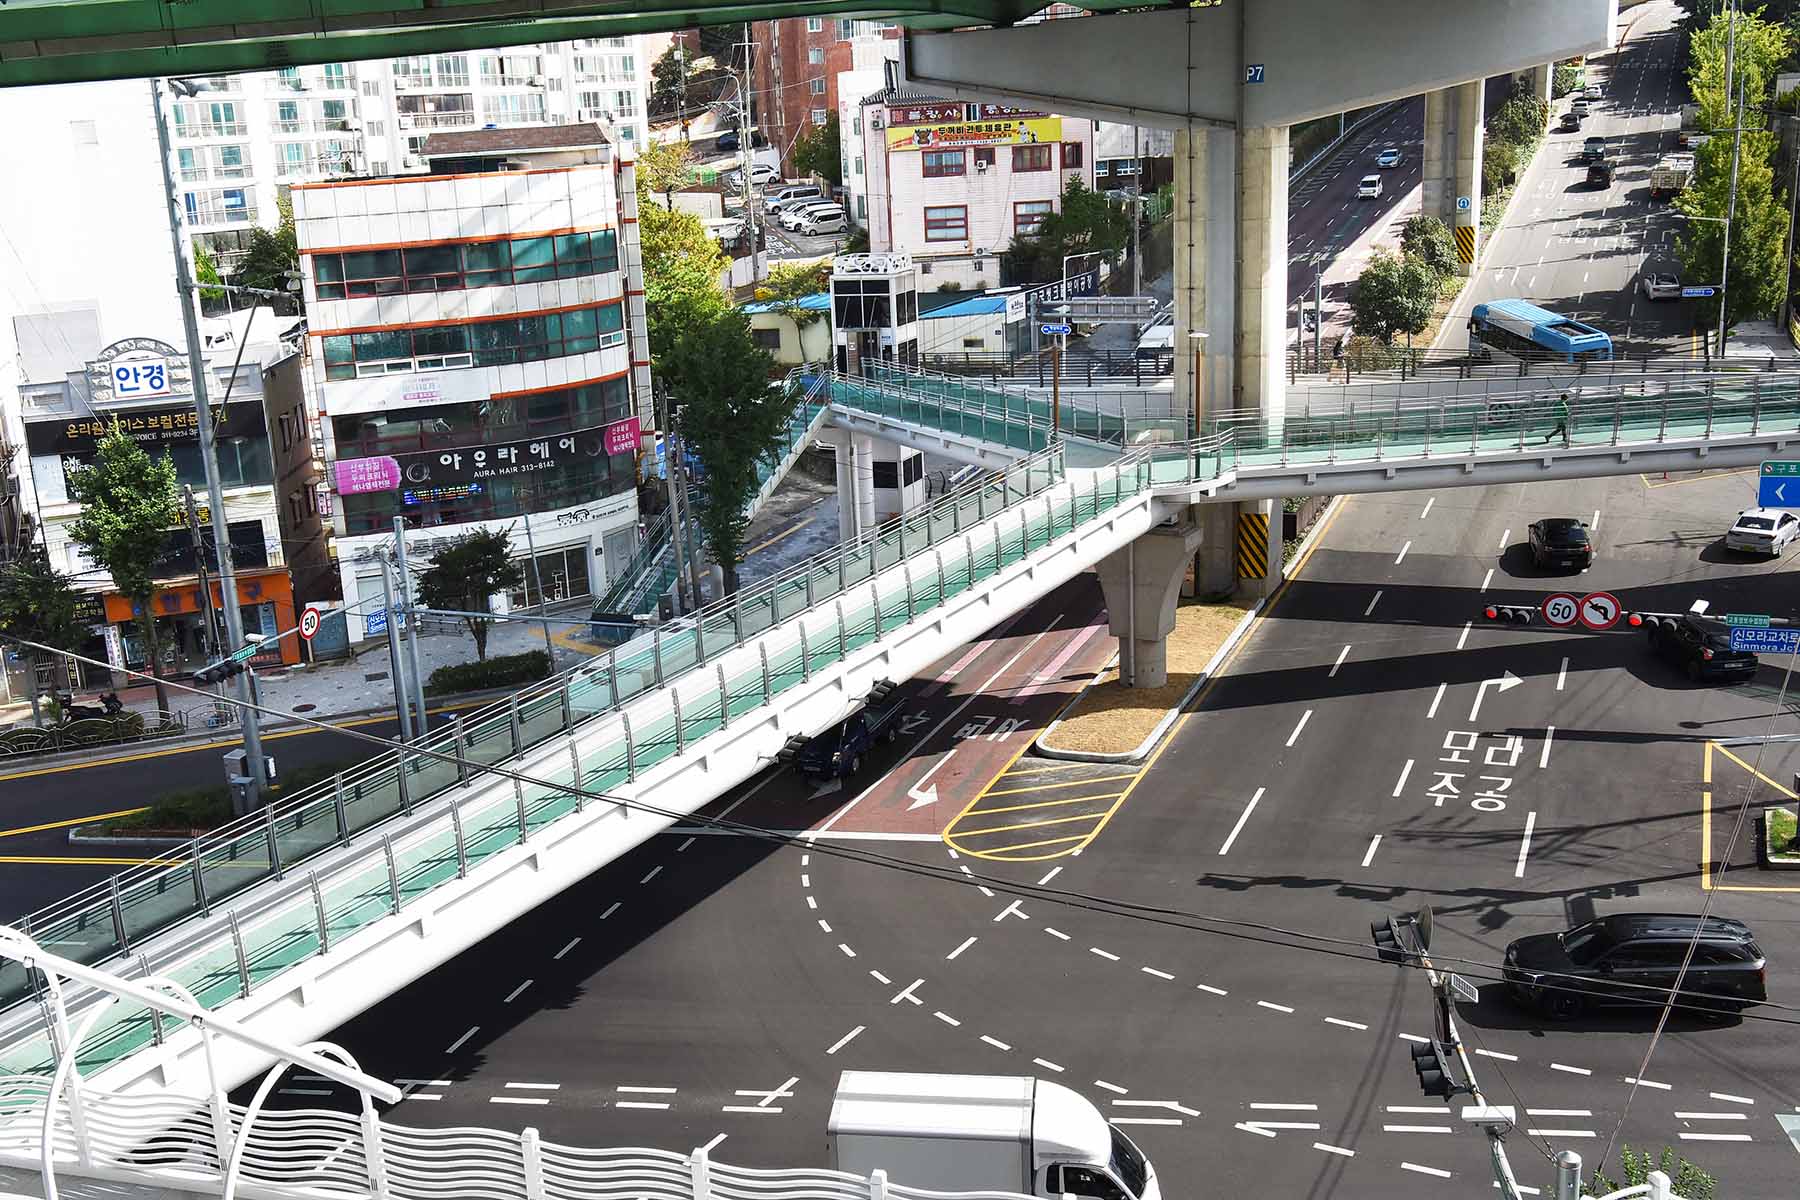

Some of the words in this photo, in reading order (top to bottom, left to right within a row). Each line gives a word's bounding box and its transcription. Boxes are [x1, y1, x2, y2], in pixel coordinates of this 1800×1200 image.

[1247, 66, 1263, 80] P7
[115, 364, 165, 392] 안경
[439, 437, 575, 470] 아우라헤어
[473, 469, 496, 479] AURA
[499, 466, 519, 475] HAIR
[521, 460, 555, 472] 313-8142
[1776, 464, 1798, 474] 구포
[1550, 602, 1572, 619] 50
[304, 615, 316, 631] 50
[1734, 630, 1799, 643] 신모라교차로
[1733, 641, 1778, 651] Sinmora
[1438, 730, 1524, 767] 모라
[1425, 771, 1513, 812] 주공
